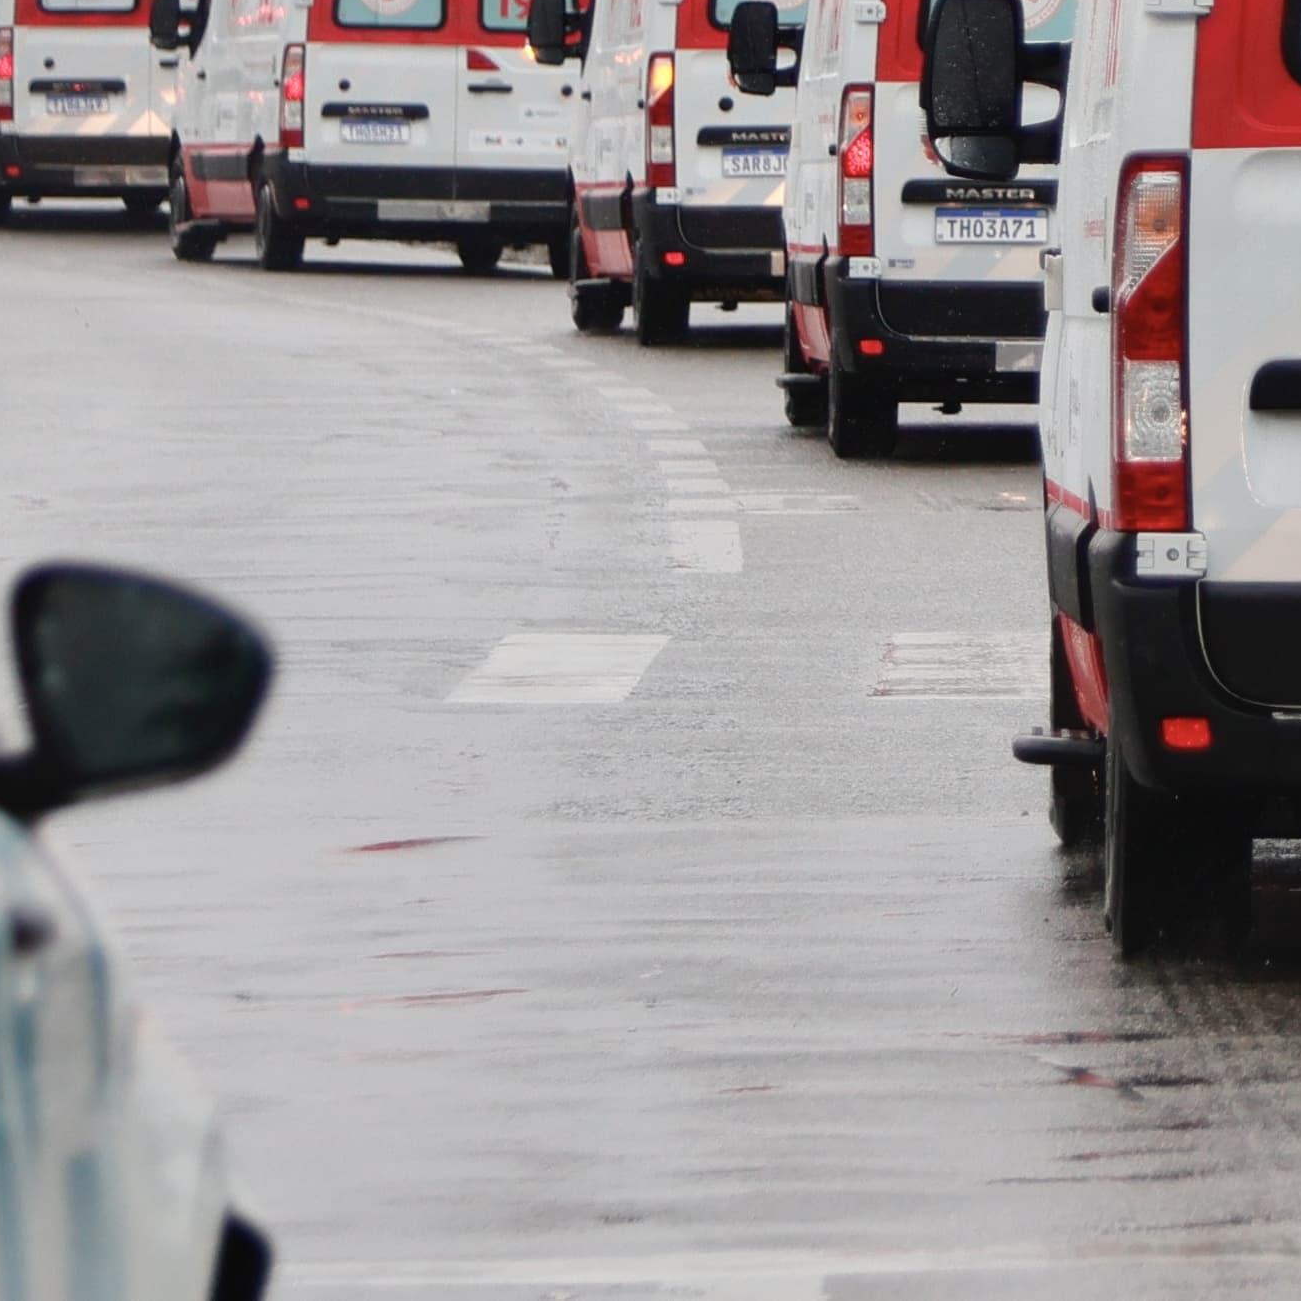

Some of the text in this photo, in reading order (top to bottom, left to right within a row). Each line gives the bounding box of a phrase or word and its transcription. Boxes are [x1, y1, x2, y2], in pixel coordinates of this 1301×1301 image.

[731, 131, 788, 142] MAST
[731, 155, 788, 173] SAR8J
[945, 188, 1035, 200] MASTER
